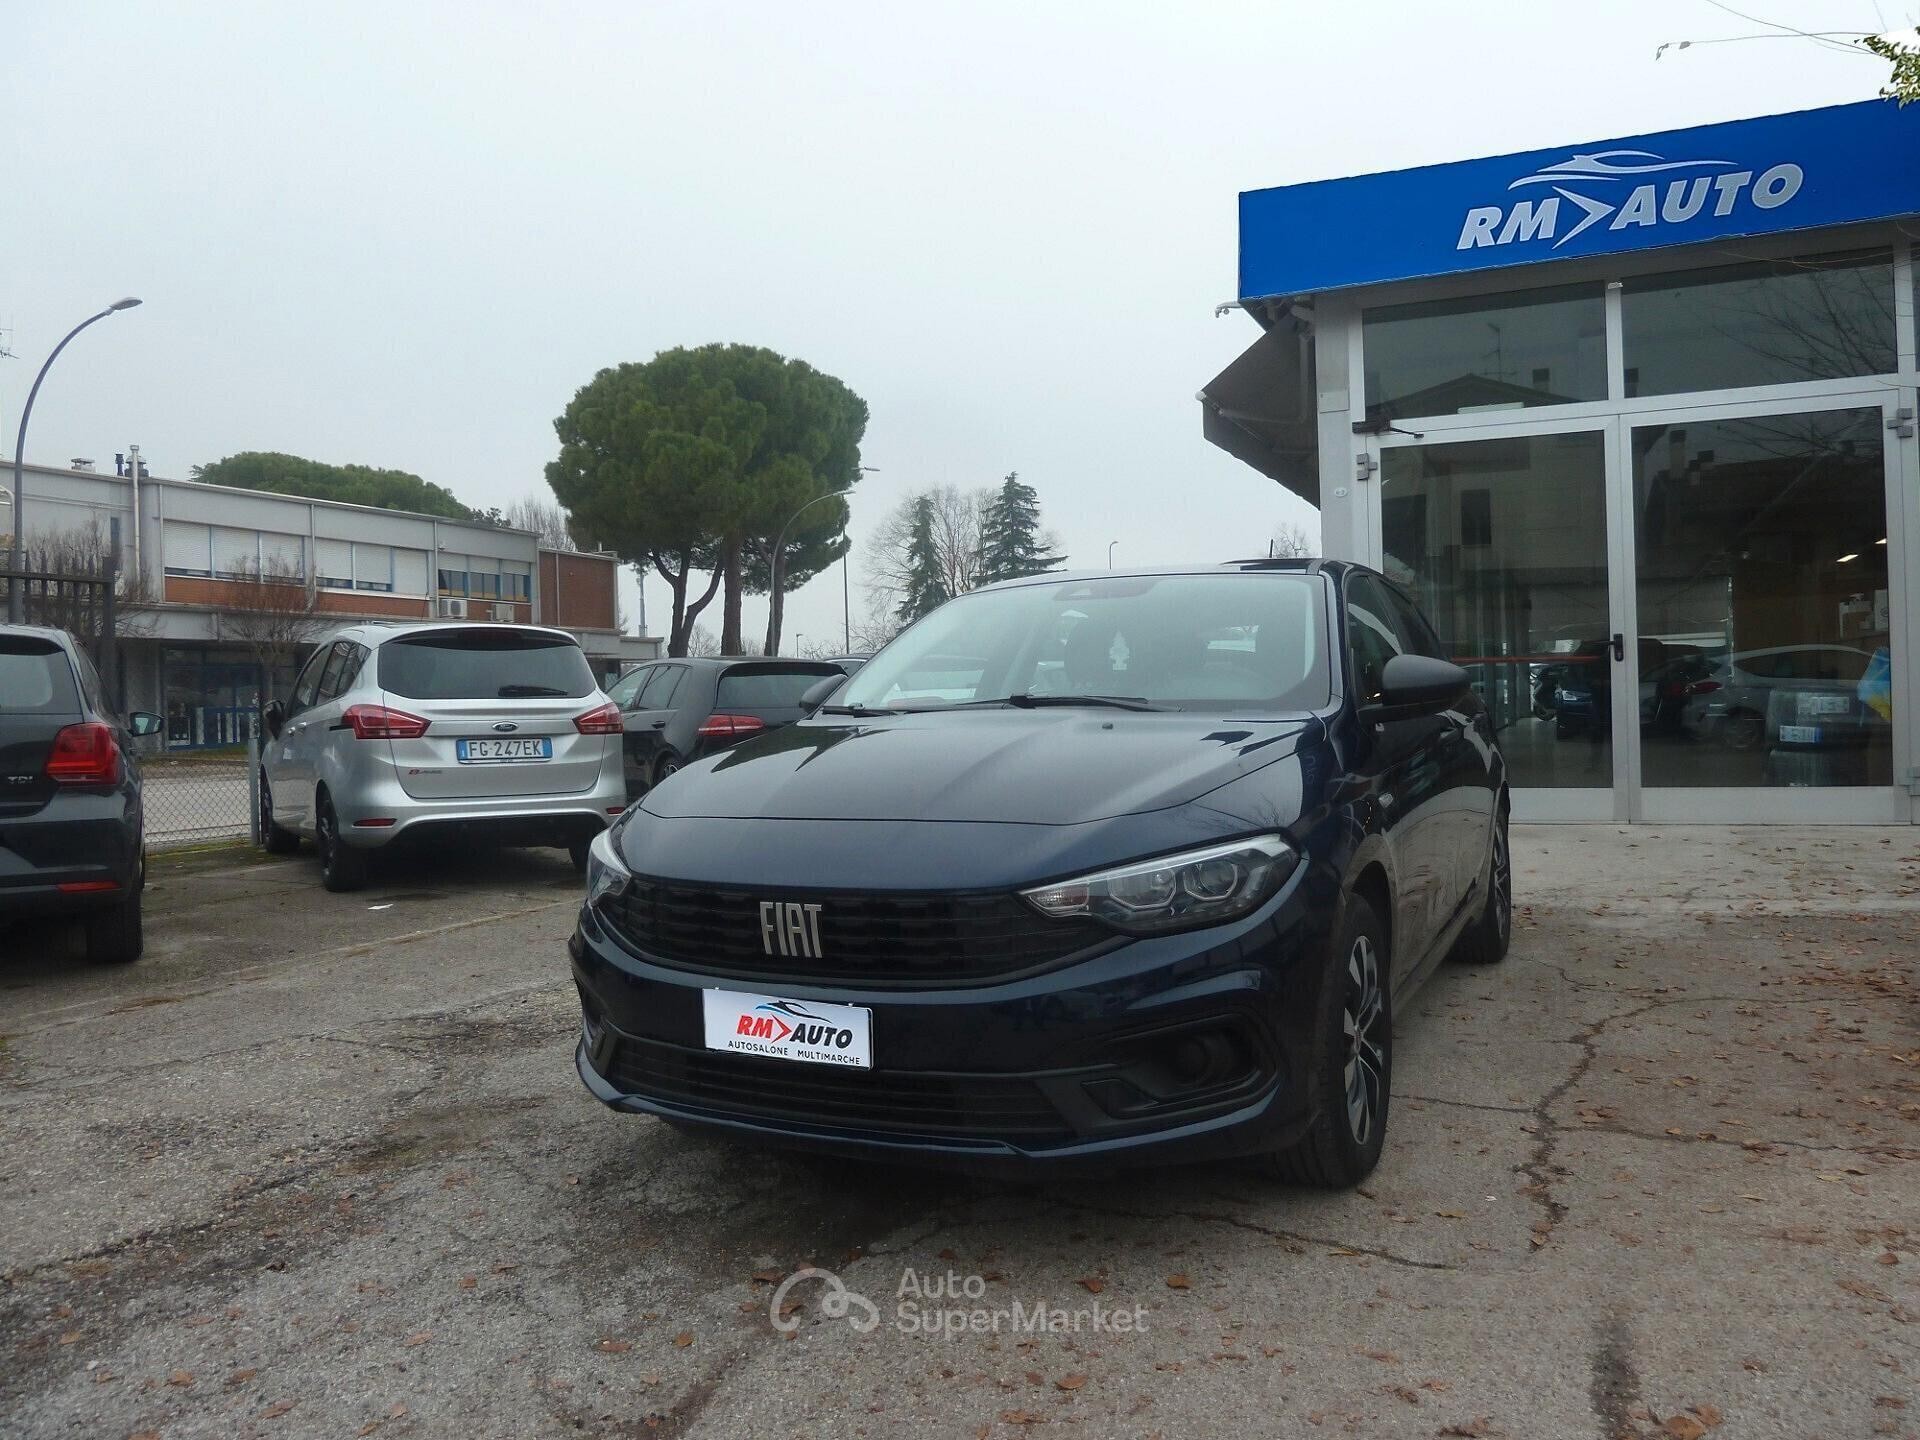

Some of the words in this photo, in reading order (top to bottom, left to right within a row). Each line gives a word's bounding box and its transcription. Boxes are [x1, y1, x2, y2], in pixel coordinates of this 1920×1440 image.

[1456, 197, 1561, 250] RM
[1608, 163, 1804, 230] AUTO
[759, 901, 823, 959] FIAT
[727, 1040, 788, 1056] AUTOSALONE
[797, 1049, 860, 1065] MULTIMARCHE
[736, 1015, 774, 1039] RM
[789, 1023, 853, 1049] AUTO
